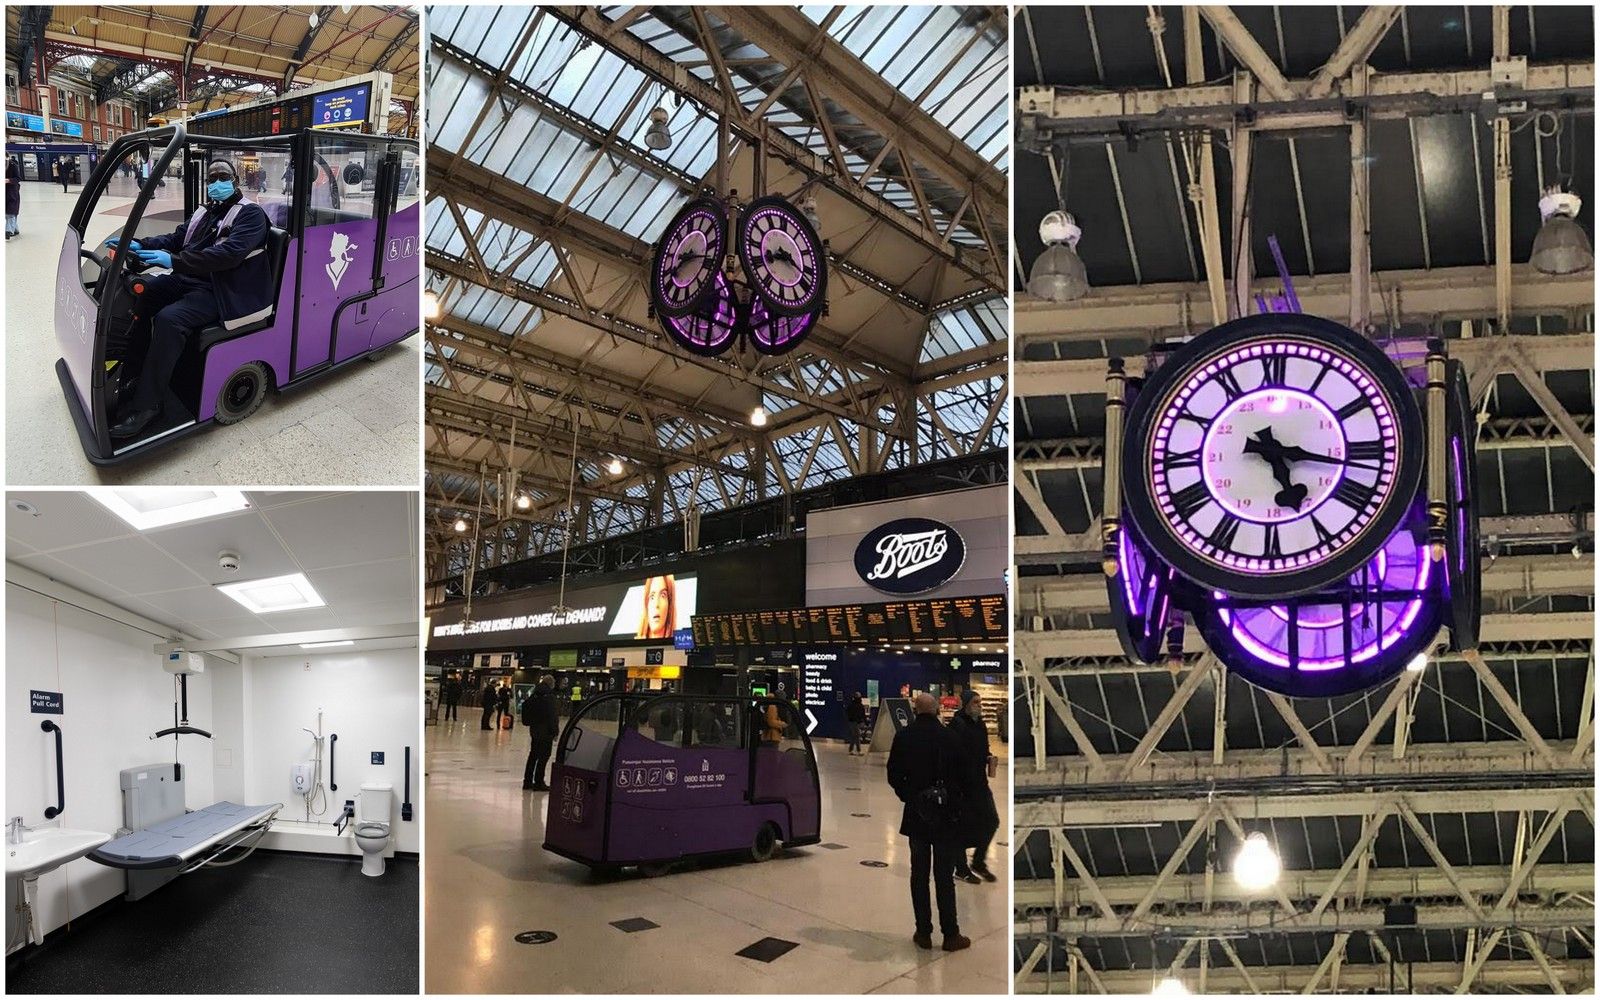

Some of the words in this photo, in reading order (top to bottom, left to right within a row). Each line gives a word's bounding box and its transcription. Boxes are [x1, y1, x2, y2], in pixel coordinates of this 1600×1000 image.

[1319, 420, 1332, 429] 14
[1216, 425, 1232, 434] 22
[1327, 448, 1341, 457] 15
[1208, 453, 1222, 462] 21
[1216, 479, 1232, 488] 20
[1318, 477, 1332, 486] 16
[1236, 499, 1251, 508] 19
[1266, 509, 1282, 518] 18
[866, 528, 948, 580] Boots
[512, 616, 527, 630] AND
[527, 612, 553, 628] COMES
[566, 607, 606, 624] DEMAND?
[805, 652, 837, 661] welcome
